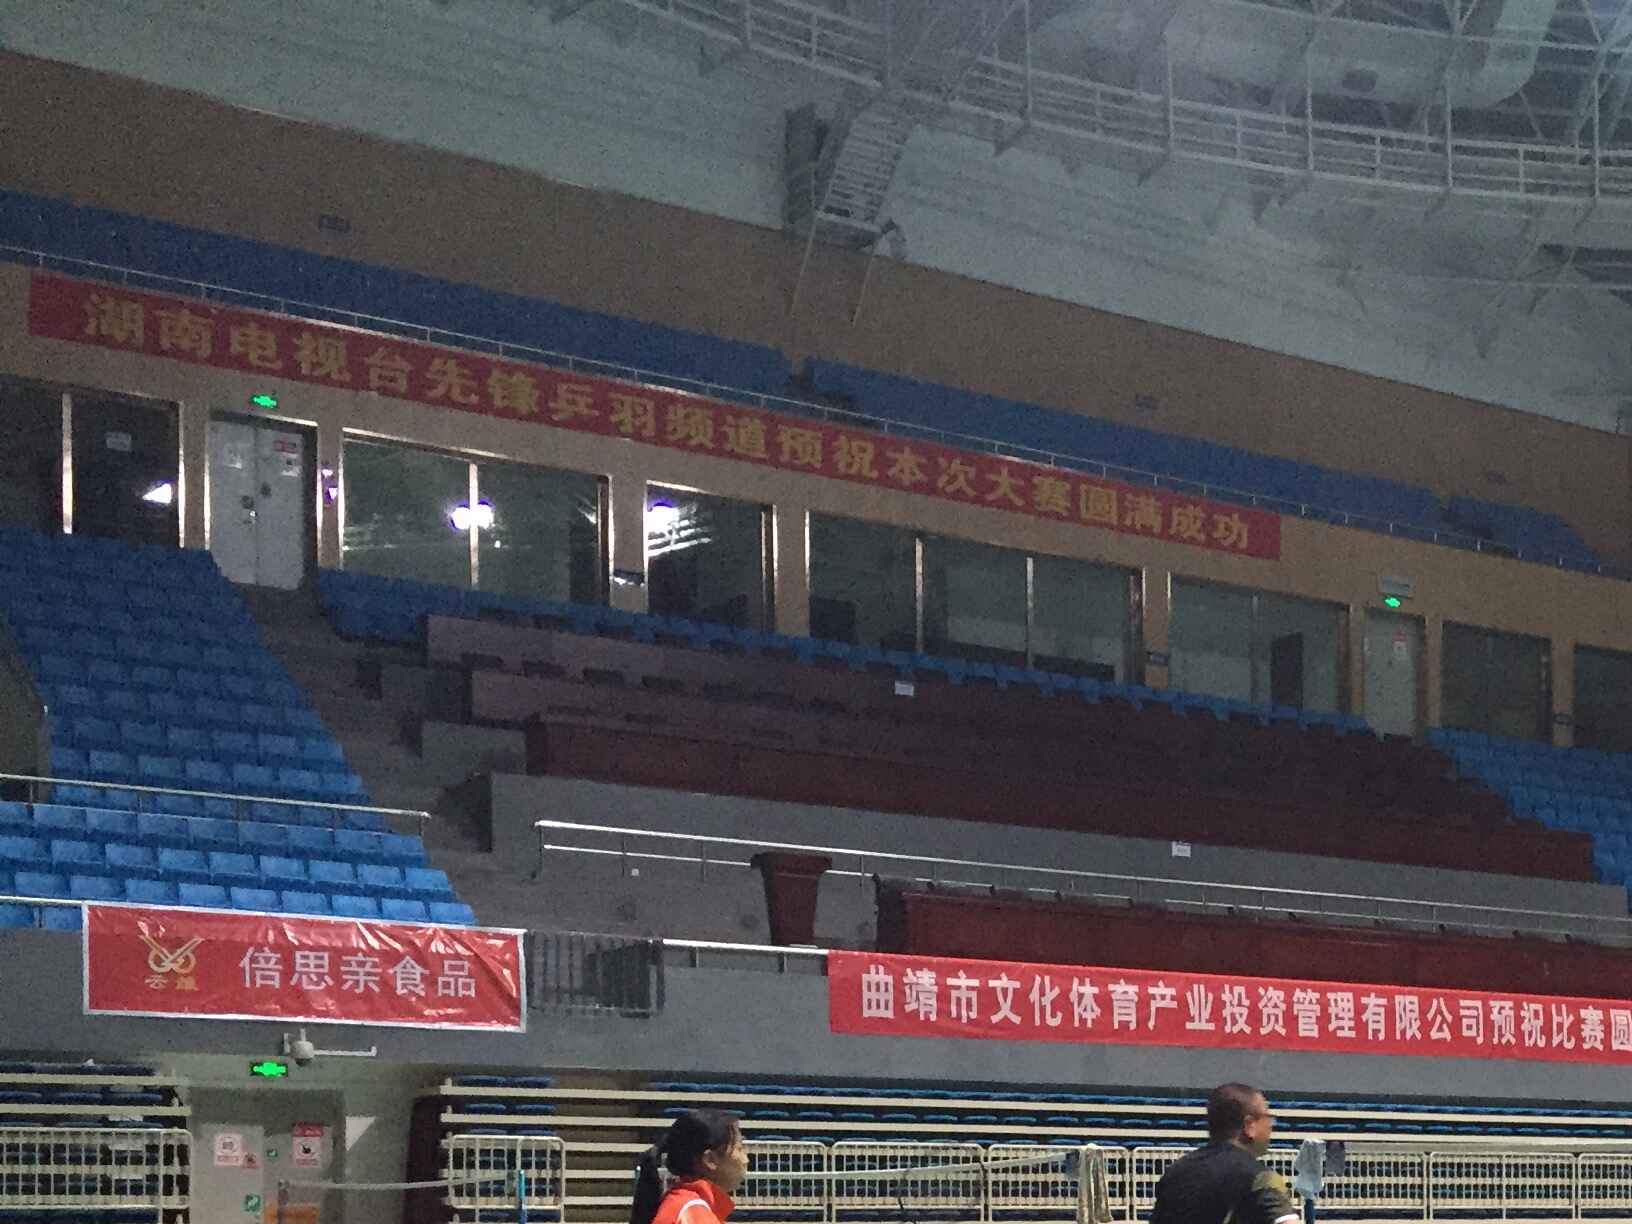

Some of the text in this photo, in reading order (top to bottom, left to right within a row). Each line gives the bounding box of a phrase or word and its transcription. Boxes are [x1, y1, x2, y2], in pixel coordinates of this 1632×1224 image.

[84, 292, 1250, 550] 湖南电视台先锋乒羽频道预祝本次大赛圆满成功
[239, 946, 477, 999] 倍思亲食品
